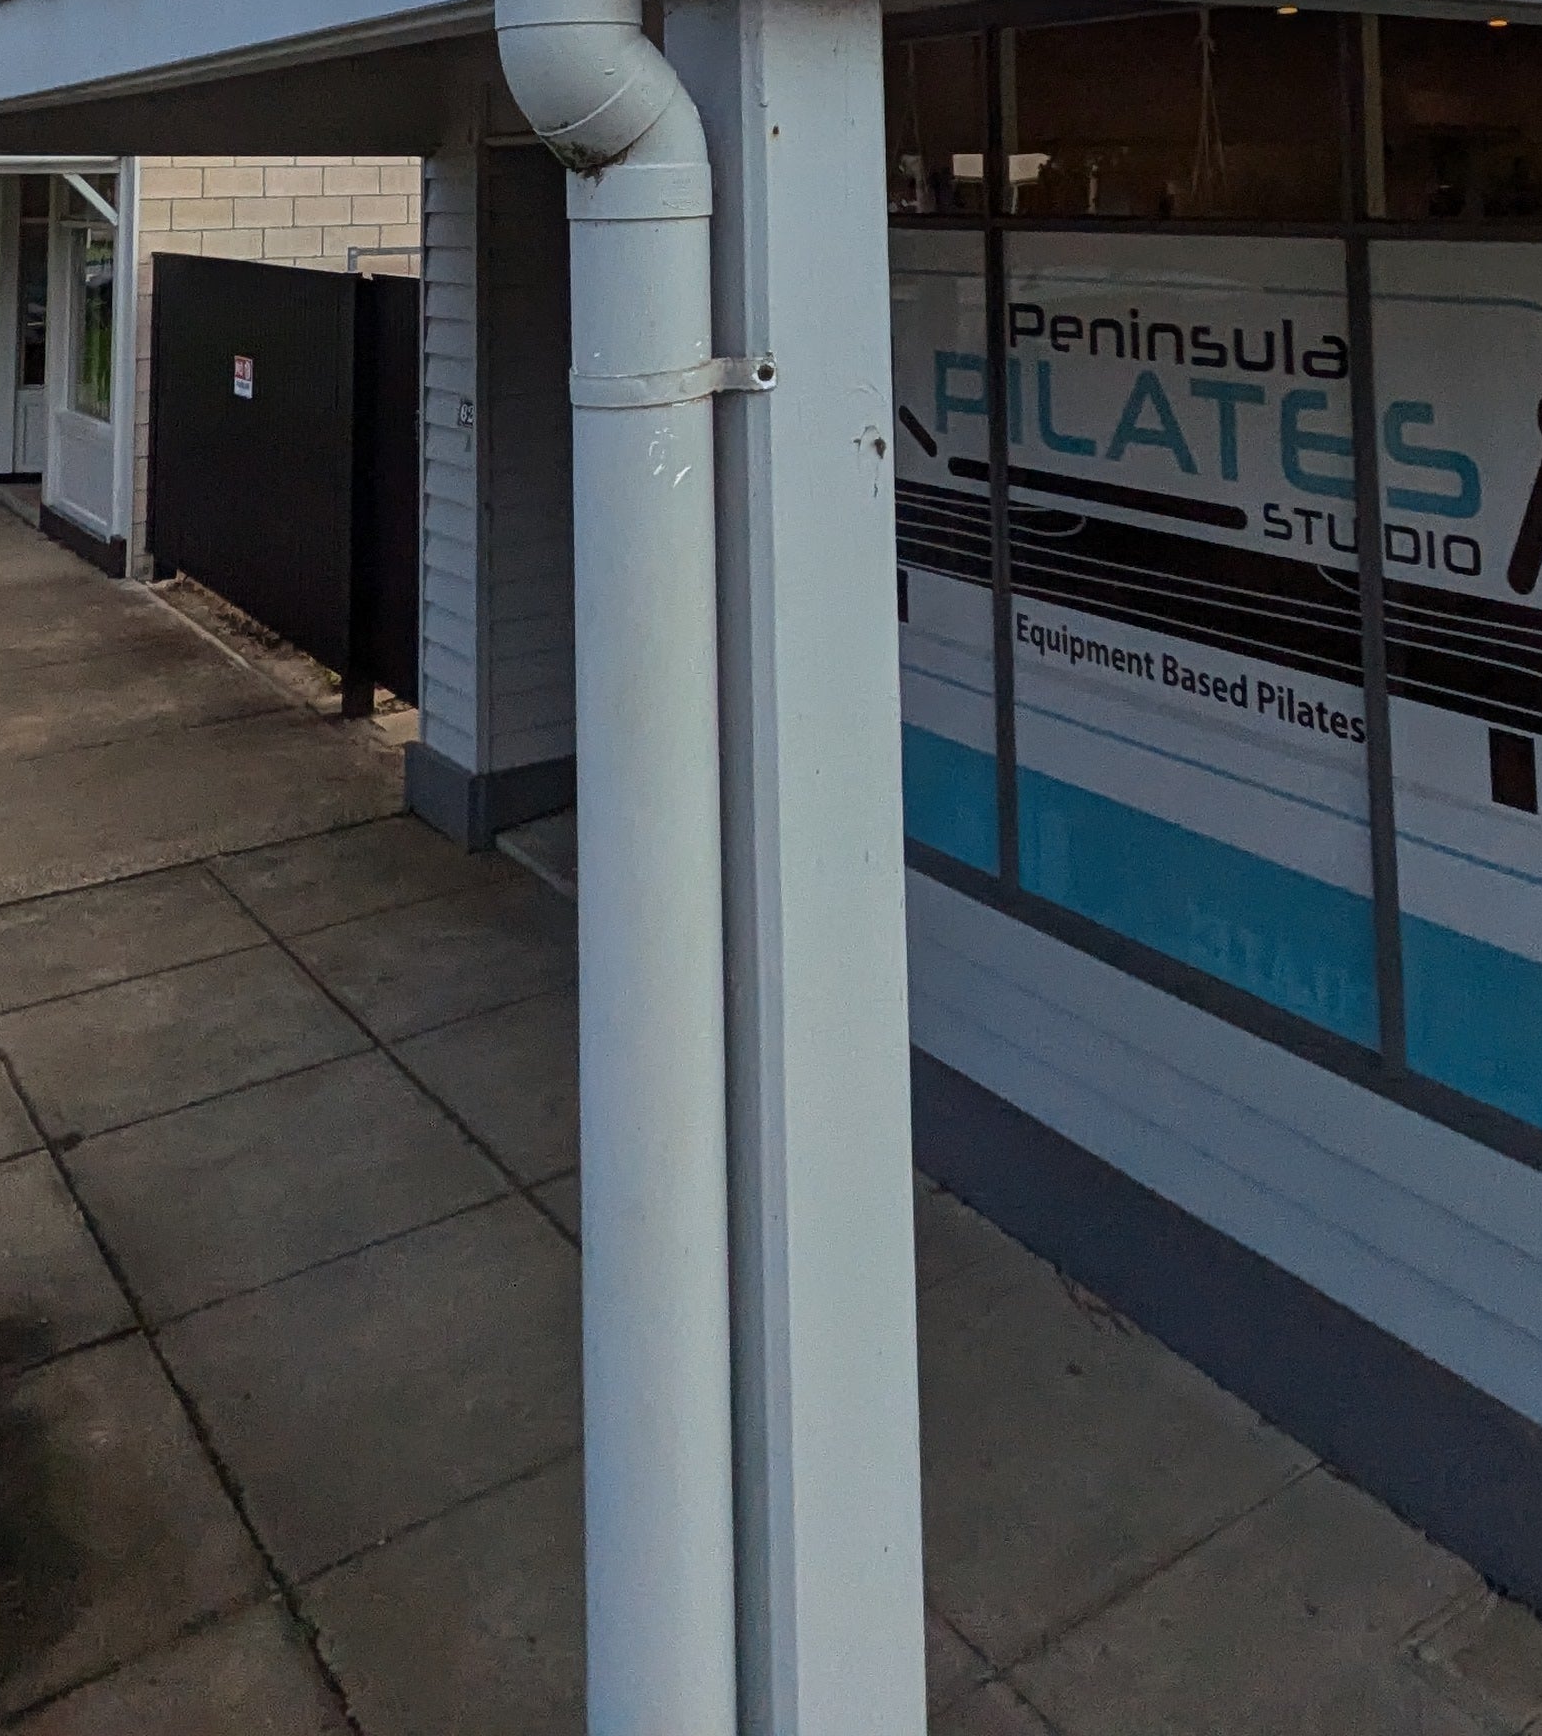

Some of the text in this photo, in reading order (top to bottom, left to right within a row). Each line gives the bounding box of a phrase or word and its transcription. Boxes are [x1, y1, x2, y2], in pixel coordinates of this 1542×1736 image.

[1008, 301, 1349, 379] Peninsula
[934, 350, 1482, 519] PILATES
[1262, 502, 1482, 576] STUDIO
[1015, 612, 1366, 744] Equipment Based Pilates
